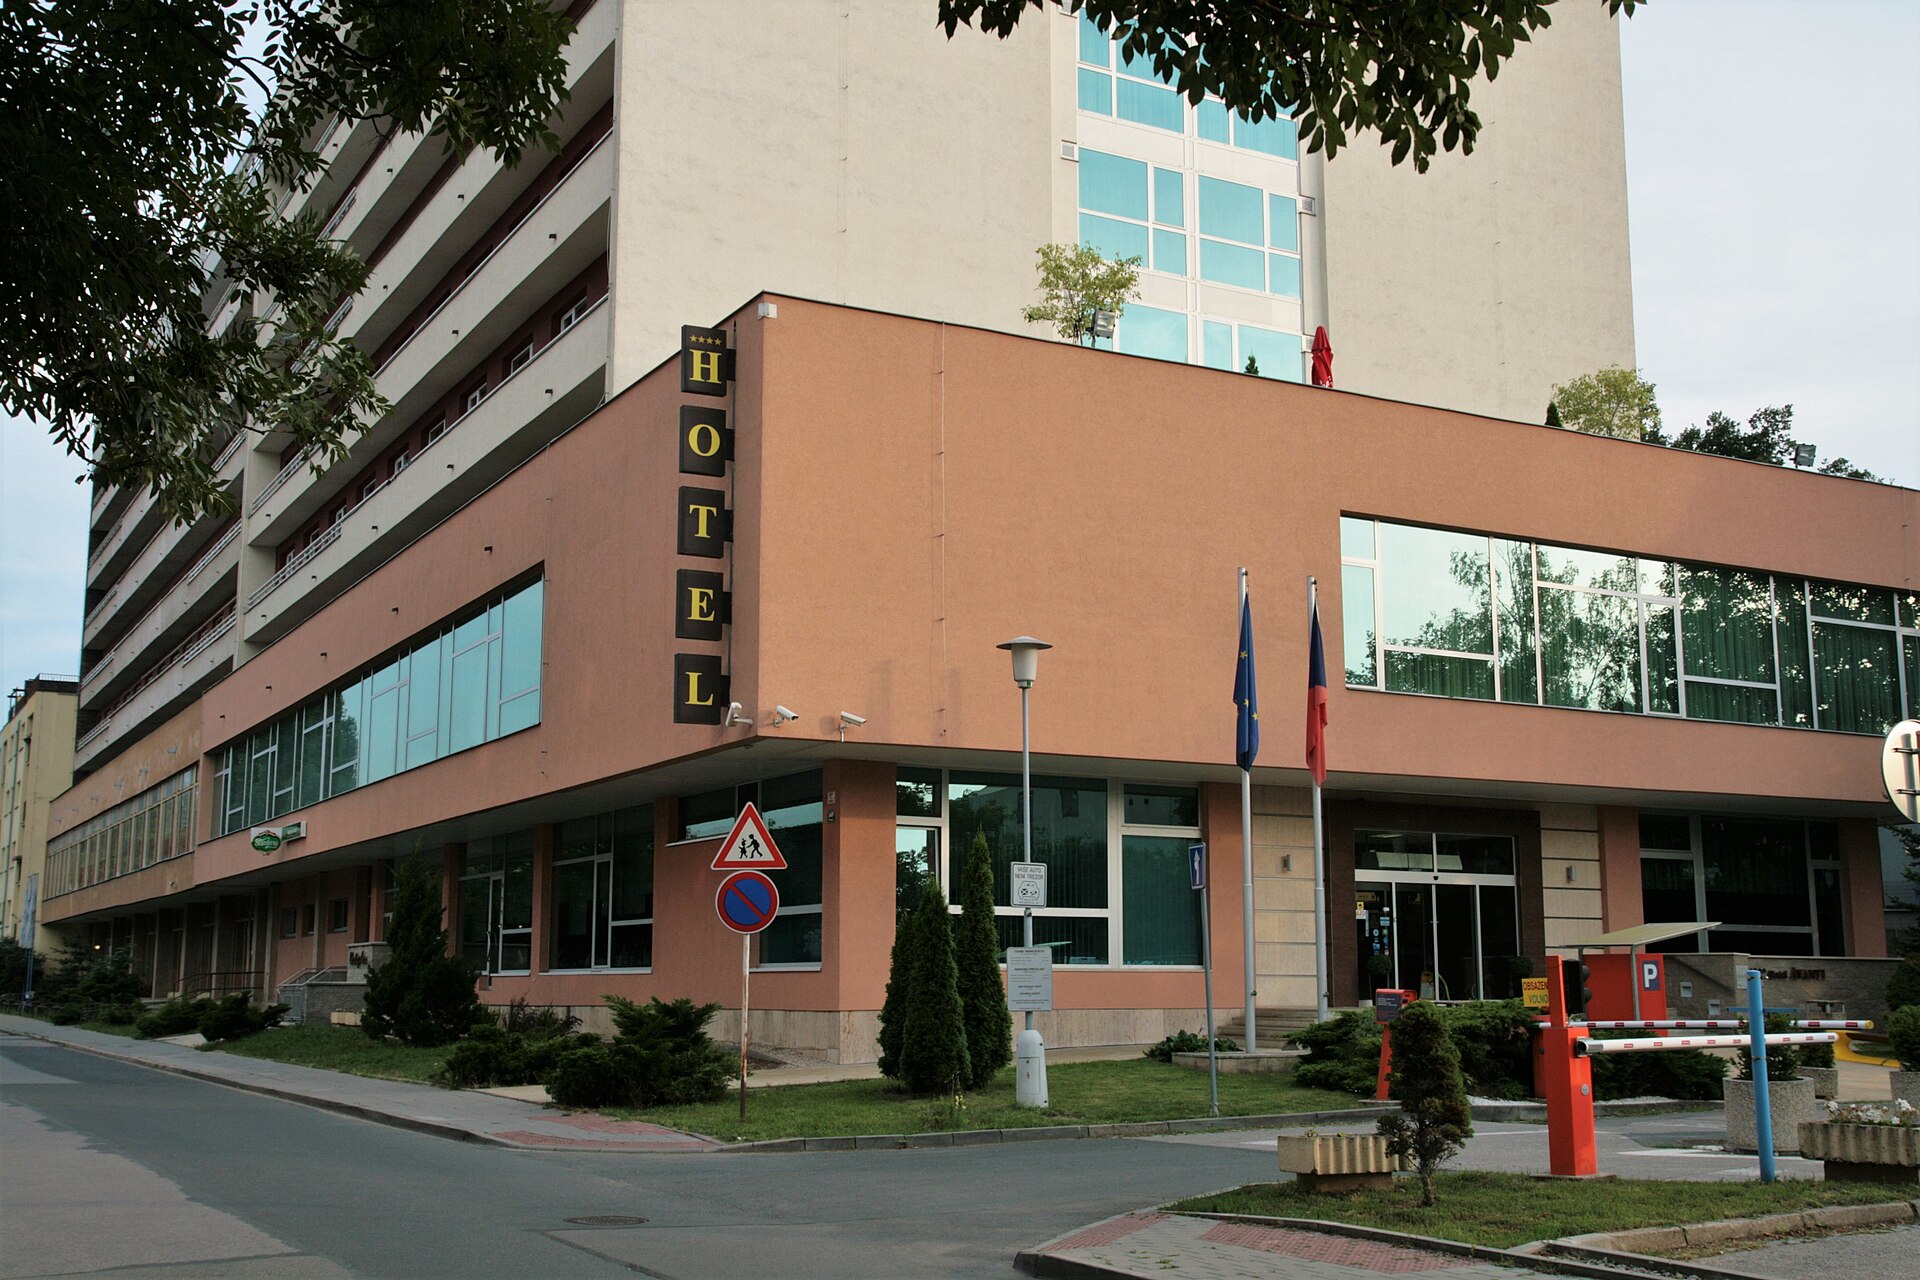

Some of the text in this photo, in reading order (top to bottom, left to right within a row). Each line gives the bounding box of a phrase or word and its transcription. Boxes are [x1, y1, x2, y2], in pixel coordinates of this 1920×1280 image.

[686, 349, 722, 706] HOTEL
[1643, 963, 1658, 988] P
[1523, 981, 1548, 991] OBSAZEN
[1528, 994, 1549, 1004] VOLNO
